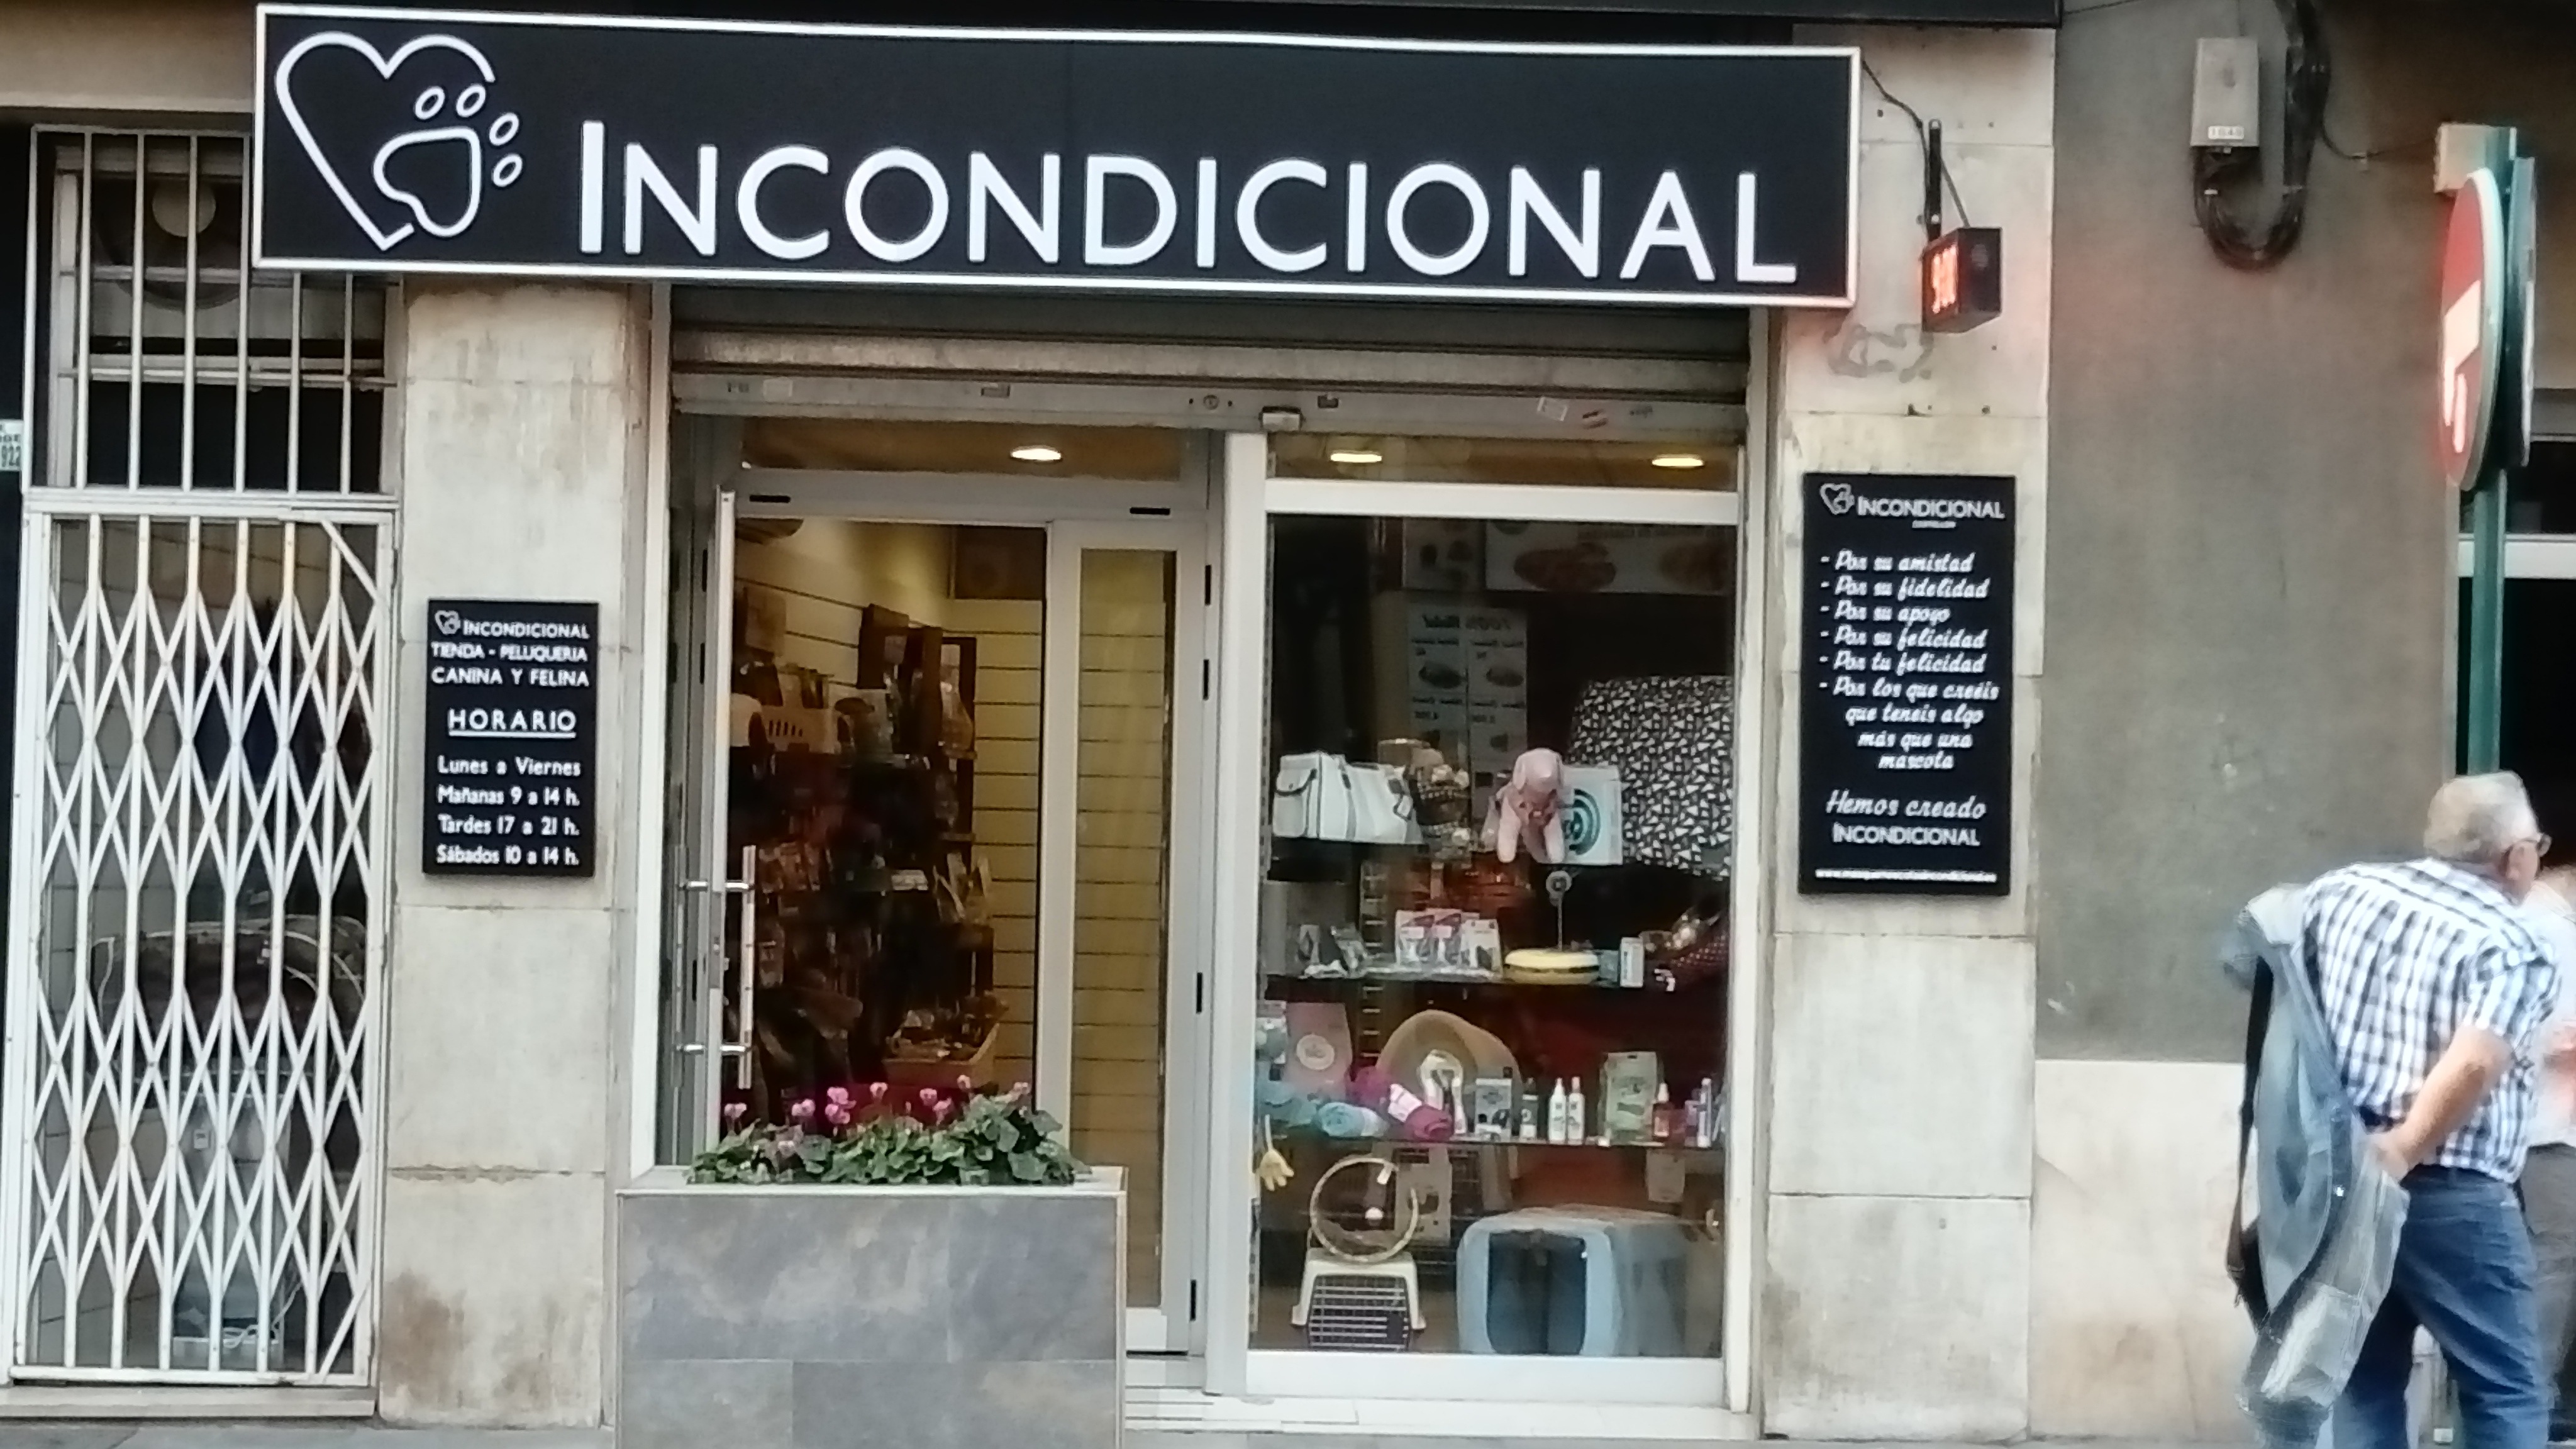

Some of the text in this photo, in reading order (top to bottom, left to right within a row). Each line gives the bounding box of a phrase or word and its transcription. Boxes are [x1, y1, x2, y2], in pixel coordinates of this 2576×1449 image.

[580, 121, 1796, 285] INCONDICIONAL
[1858, 496, 2004, 518] INCONDICIONAL
[1835, 550, 1867, 570] Por
[1874, 557, 1892, 570] su
[1898, 553, 1975, 572] amistad
[1835, 575, 1867, 595] Por
[1874, 582, 1892, 596] su
[1898, 577, 1990, 601] fidelidad
[1835, 600, 1867, 620] Por
[1874, 607, 1892, 621] su
[1897, 608, 1950, 625] apoyo
[464, 620, 589, 638] INCONDICIONAL
[1835, 625, 1867, 645] Por
[1874, 632, 1892, 645] su
[1897, 626, 1987, 651] felicidad
[431, 641, 485, 658] TIENDA
[500, 644, 587, 662] PELUQUERIA
[1834, 650, 1865, 670] Por
[1872, 652, 1891, 670] tu
[1896, 652, 1987, 675] felicidad
[431, 667, 589, 686] CANINA Y FELINA
[1833, 676, 1865, 696] Por
[1872, 677, 1902, 697] los
[1906, 684, 1938, 702] que
[448, 709, 575, 731] HORARIO
[1846, 708, 1877, 726] que
[1941, 703, 1984, 728] algo
[1858, 732, 1972, 751] más que una
[438, 755, 580, 776] Lunes a Viernes
[1879, 750, 1953, 769] mascota
[438, 784, 579, 806] Mañanas 9 a 14 h.
[1826, 790, 1985, 818] Hemos creado
[438, 814, 579, 835] Tardes 17 a 21 h.
[1833, 823, 1980, 845] INCONDICIONAL
[437, 844, 579, 865] Sábados 10 a 14 h.
